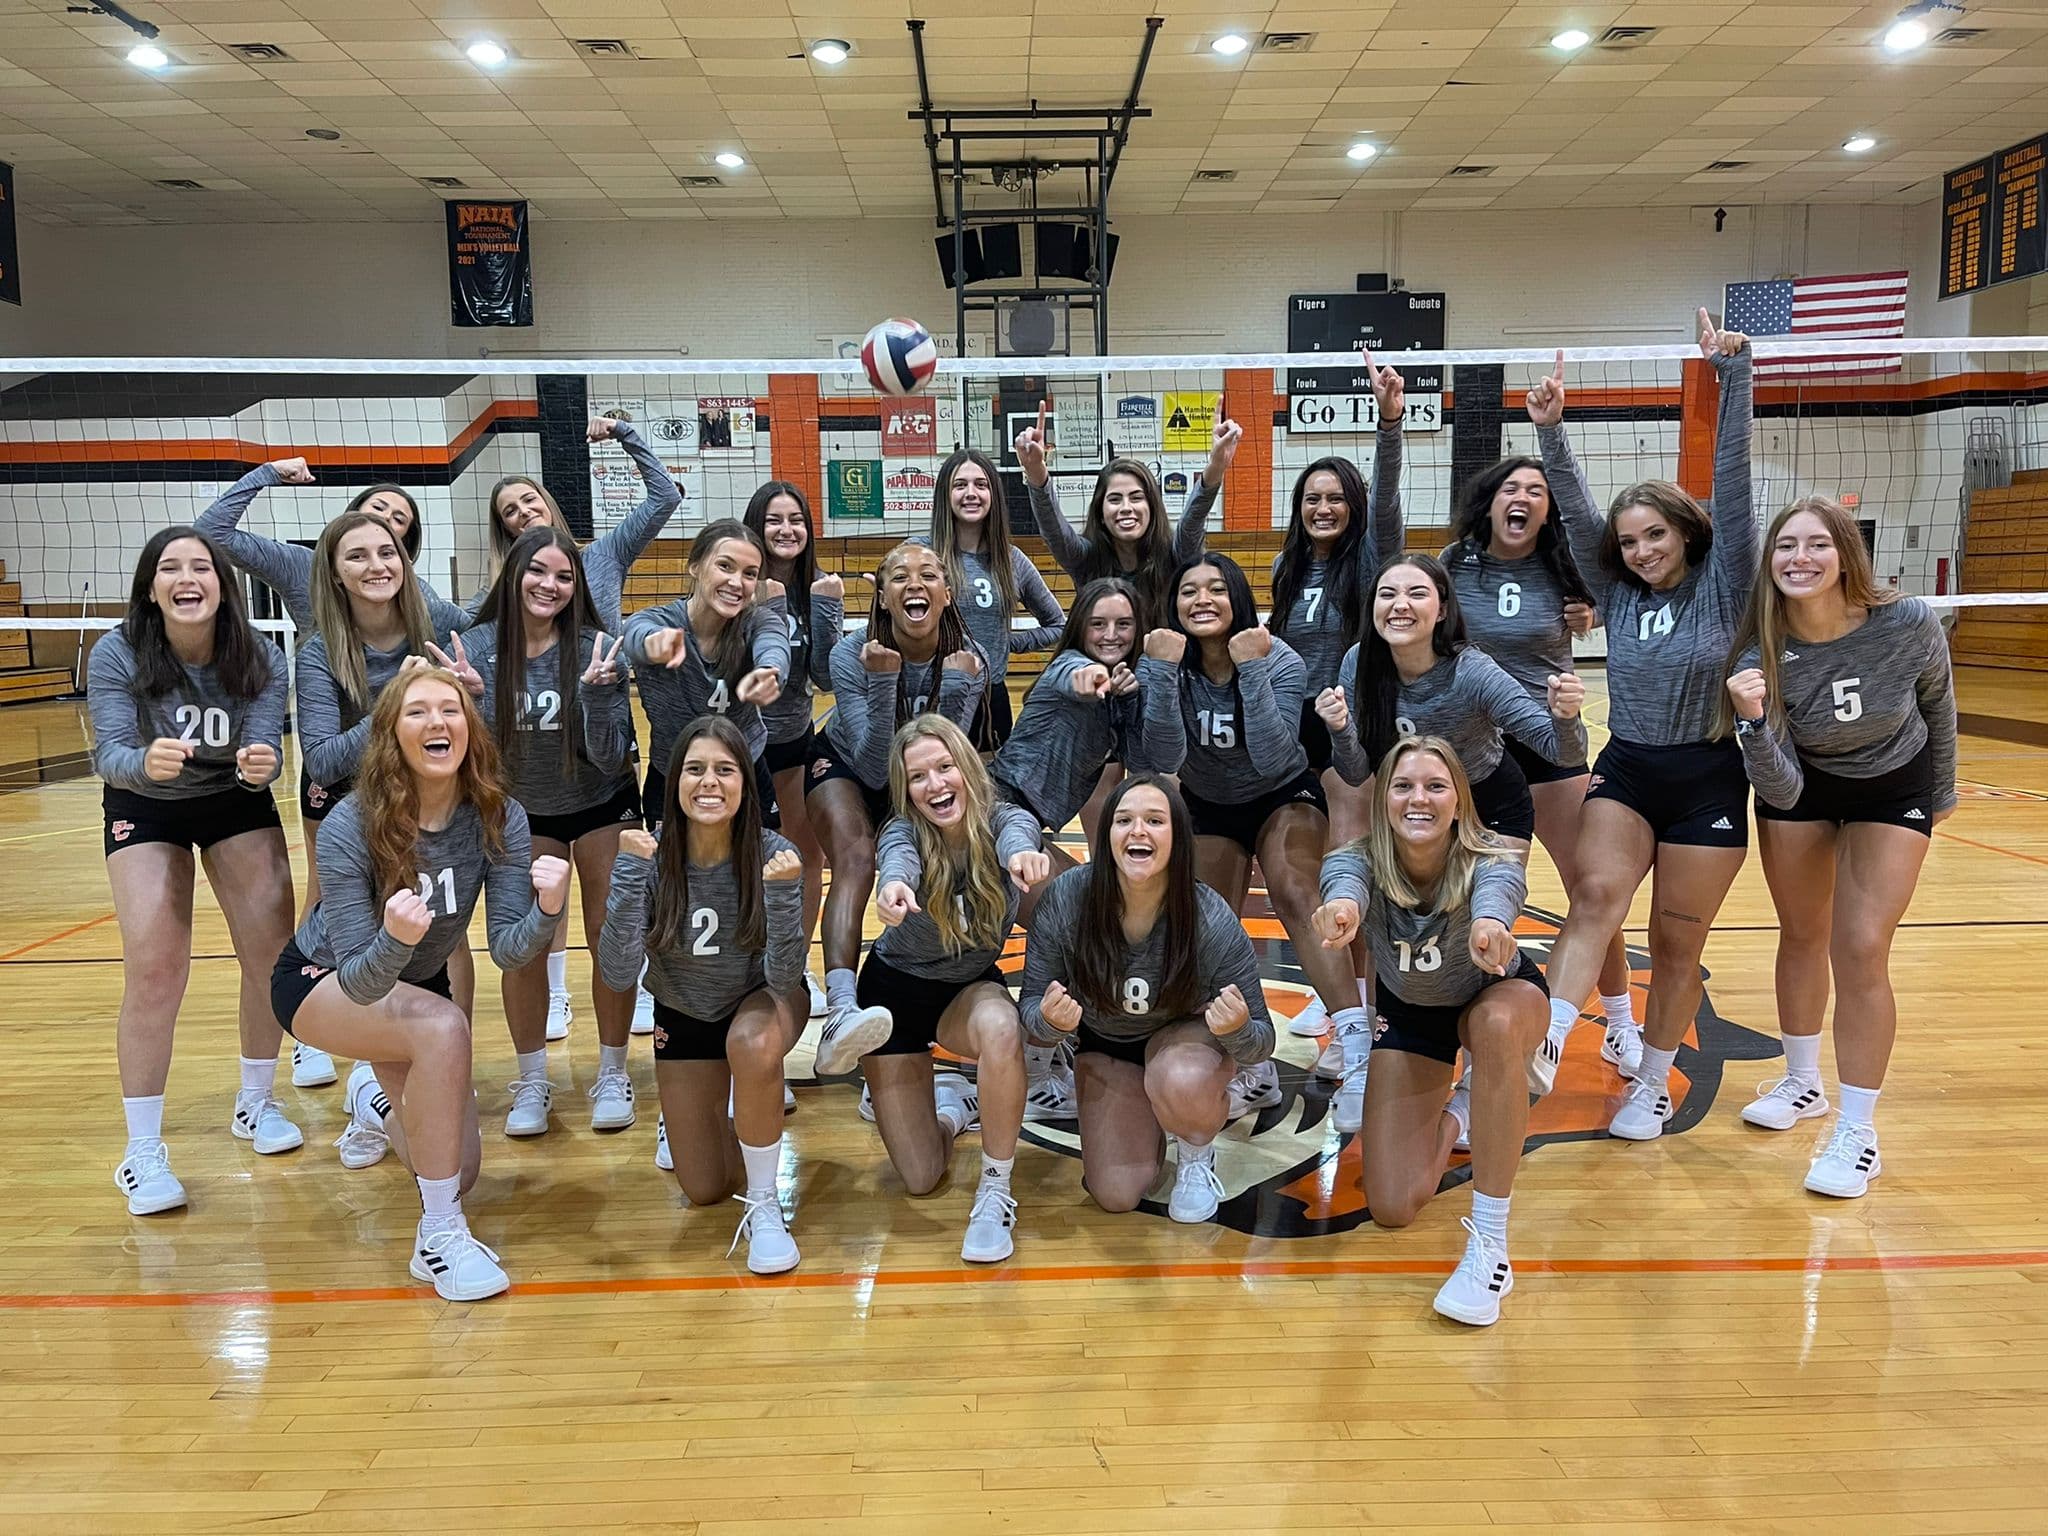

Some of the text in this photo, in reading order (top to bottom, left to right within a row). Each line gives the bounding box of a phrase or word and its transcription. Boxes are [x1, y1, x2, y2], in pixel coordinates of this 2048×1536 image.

[2004, 144, 2041, 169] BASKETBALL
[1952, 165, 1985, 189] BASKETBALL
[457, 205, 517, 231] NAIA
[457, 255, 475, 265] 2021
[479, 243, 520, 253] VOLLEYBALL
[1297, 299, 1326, 310] Tigers
[1409, 298, 1441, 310] Guests
[1352, 338, 1383, 350] period
[1296, 378, 1317, 388] fouls
[1352, 377, 1371, 388] play
[1417, 377, 1438, 387] fouls
[1296, 397, 1436, 424] Go Tirs
[973, 578, 993, 608] 3
[1303, 587, 1324, 622] 7
[1498, 582, 1521, 618] 6
[1638, 602, 1676, 642] 14
[707, 679, 731, 713] 4
[1831, 677, 1863, 722] 5
[175, 705, 230, 747] 20
[1196, 709, 1236, 748] 15
[414, 867, 458, 918] 21
[691, 907, 720, 956] 2
[1123, 977, 1149, 1015] 8
